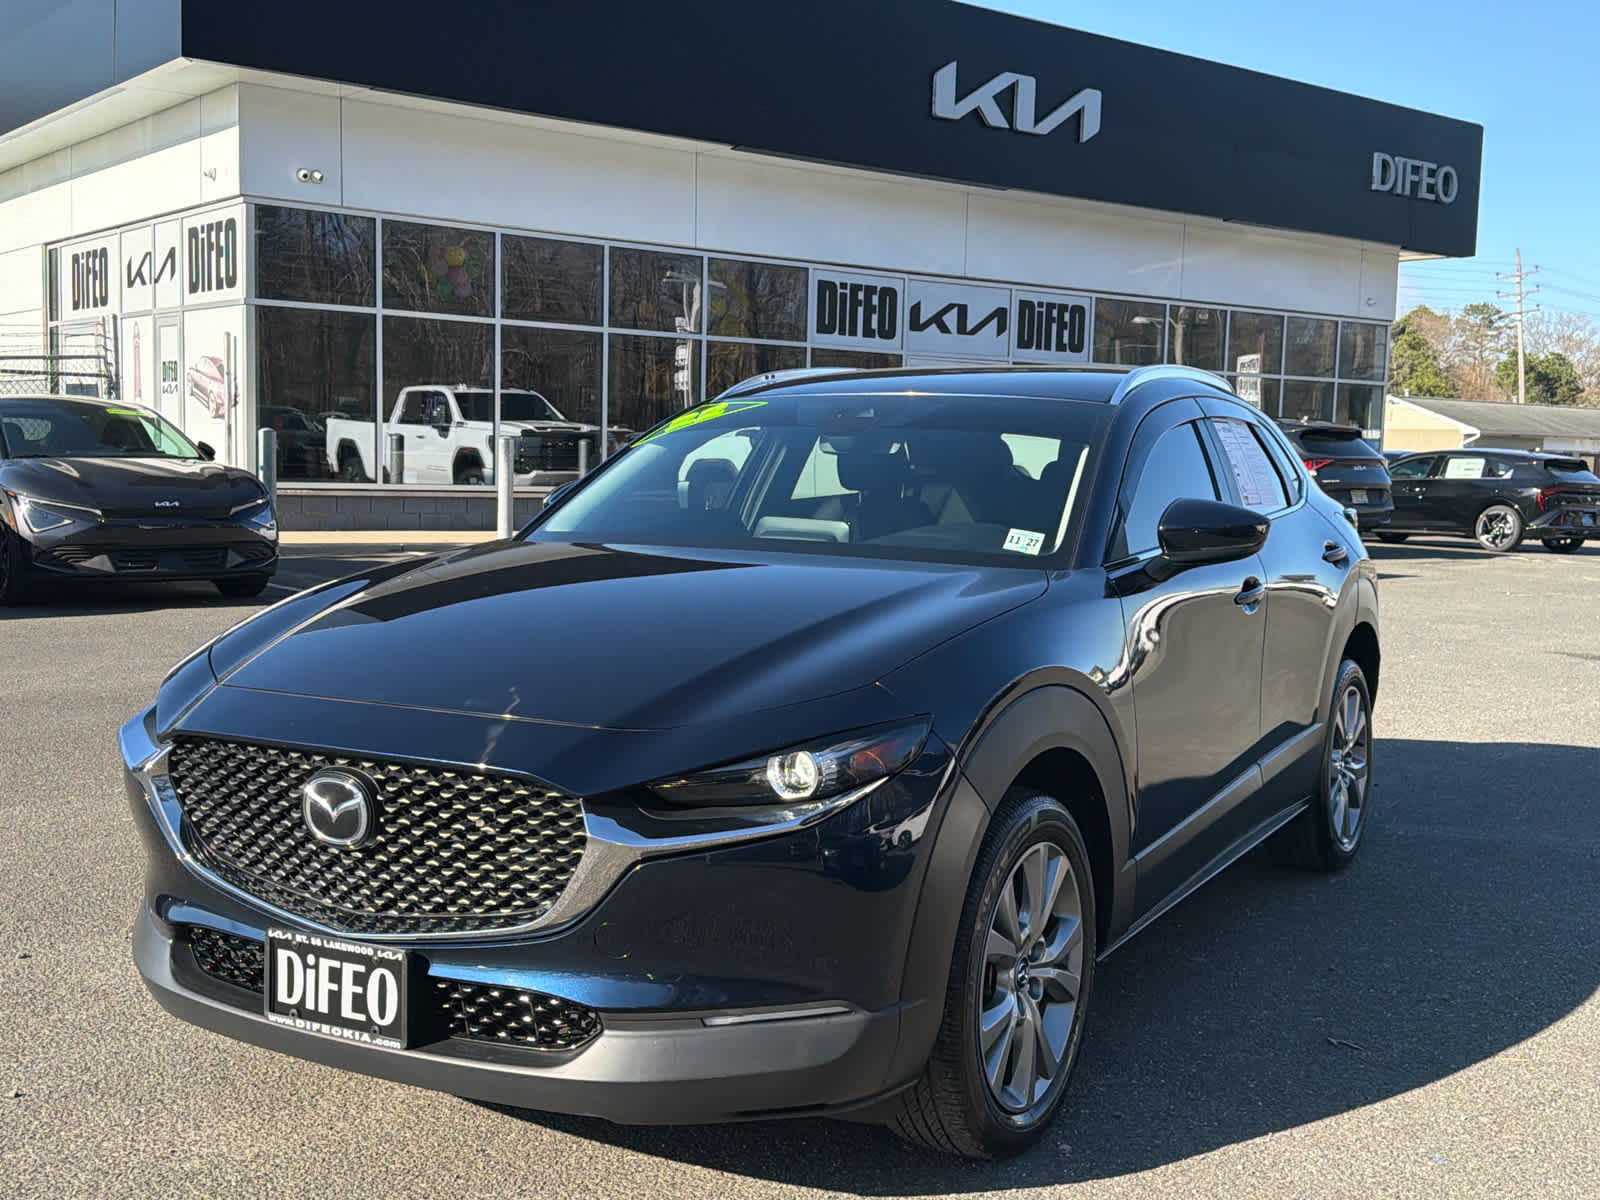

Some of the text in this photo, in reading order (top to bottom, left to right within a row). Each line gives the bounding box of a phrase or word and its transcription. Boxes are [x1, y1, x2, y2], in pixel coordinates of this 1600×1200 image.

[1371, 152, 1458, 204] DIFEO
[71, 247, 109, 311] DiFEO
[188, 217, 238, 295] DiFEO
[816, 279, 897, 340] DiFEO
[1016, 299, 1086, 353] DiFEO
[323, 940, 375, 956] LAKEWOOD
[276, 948, 399, 1027] DiFEO
